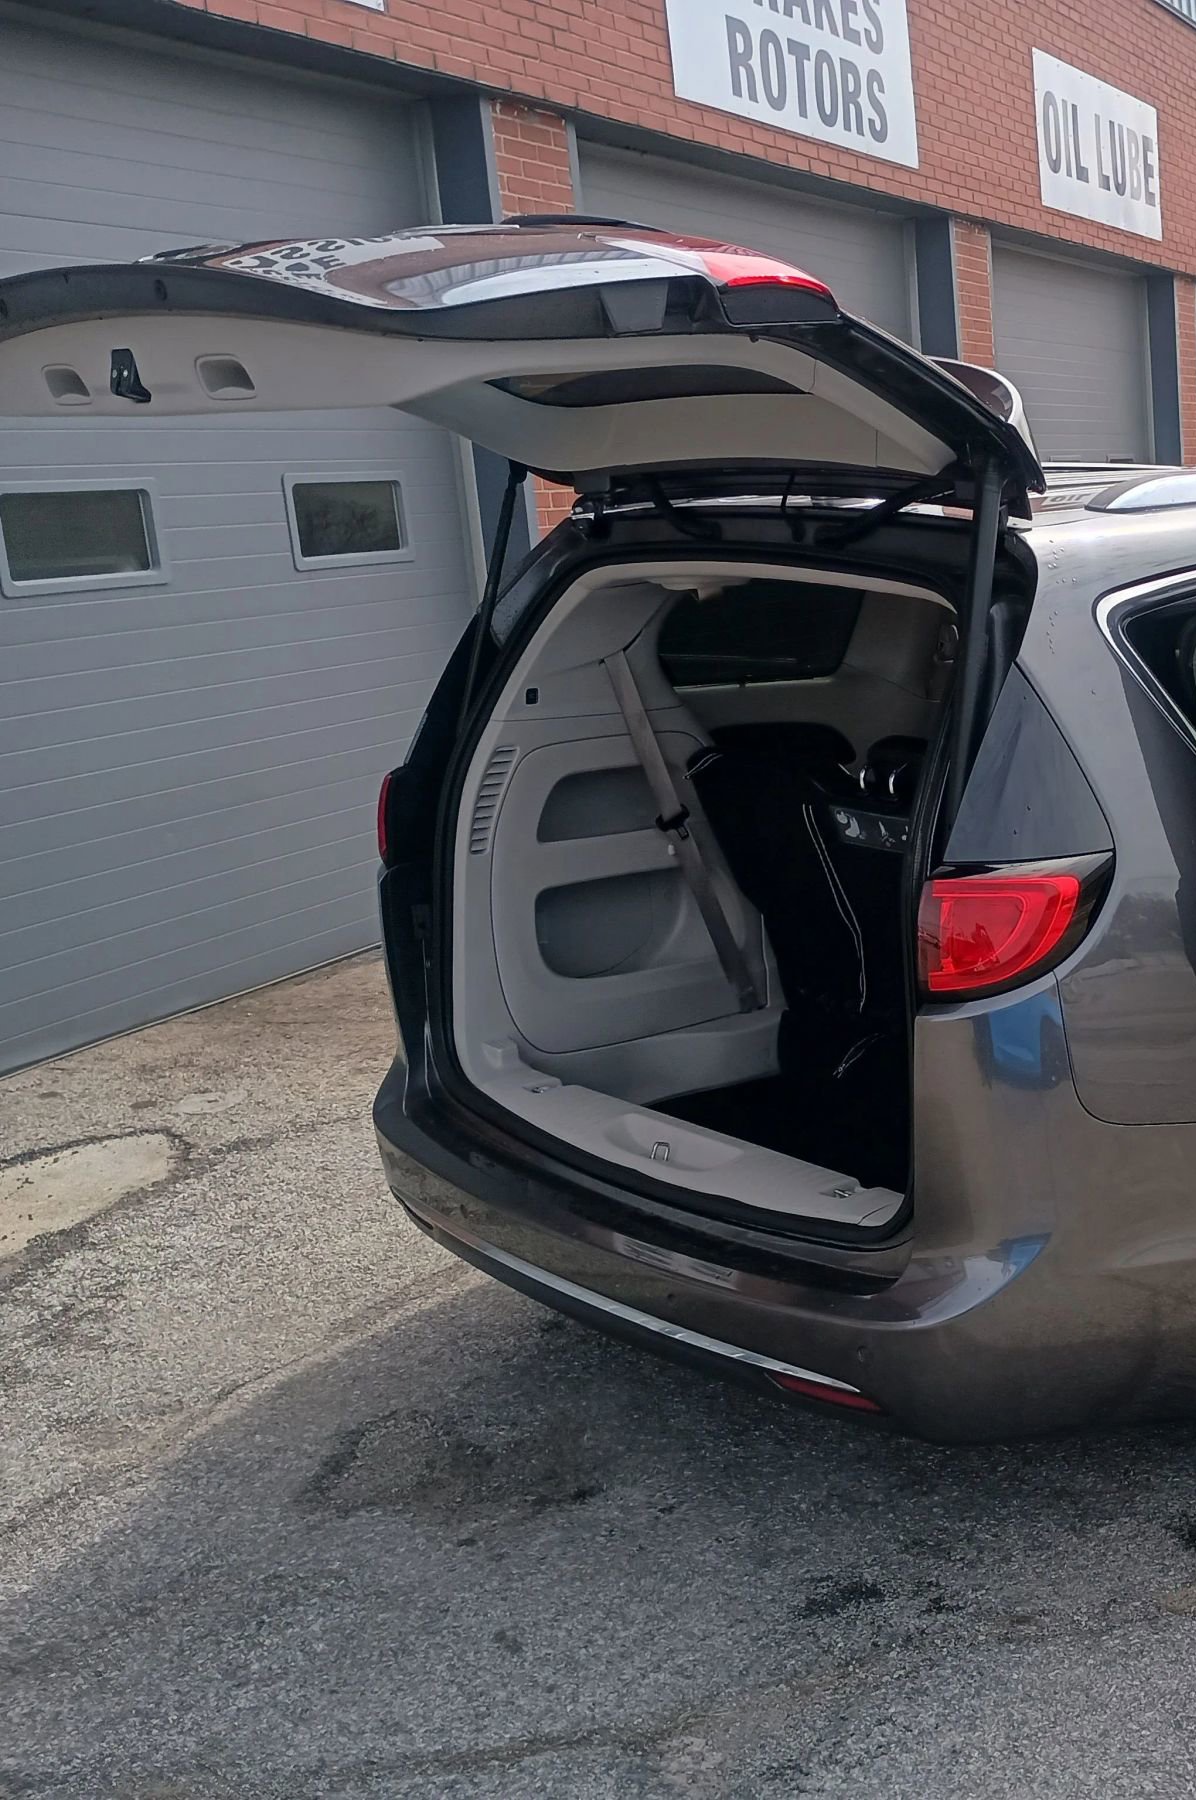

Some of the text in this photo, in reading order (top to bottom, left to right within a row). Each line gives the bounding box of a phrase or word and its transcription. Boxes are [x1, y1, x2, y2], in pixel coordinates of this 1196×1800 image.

[725, 14, 888, 143] ROTORS
[1042, 90, 1156, 207] OIL LUBE
